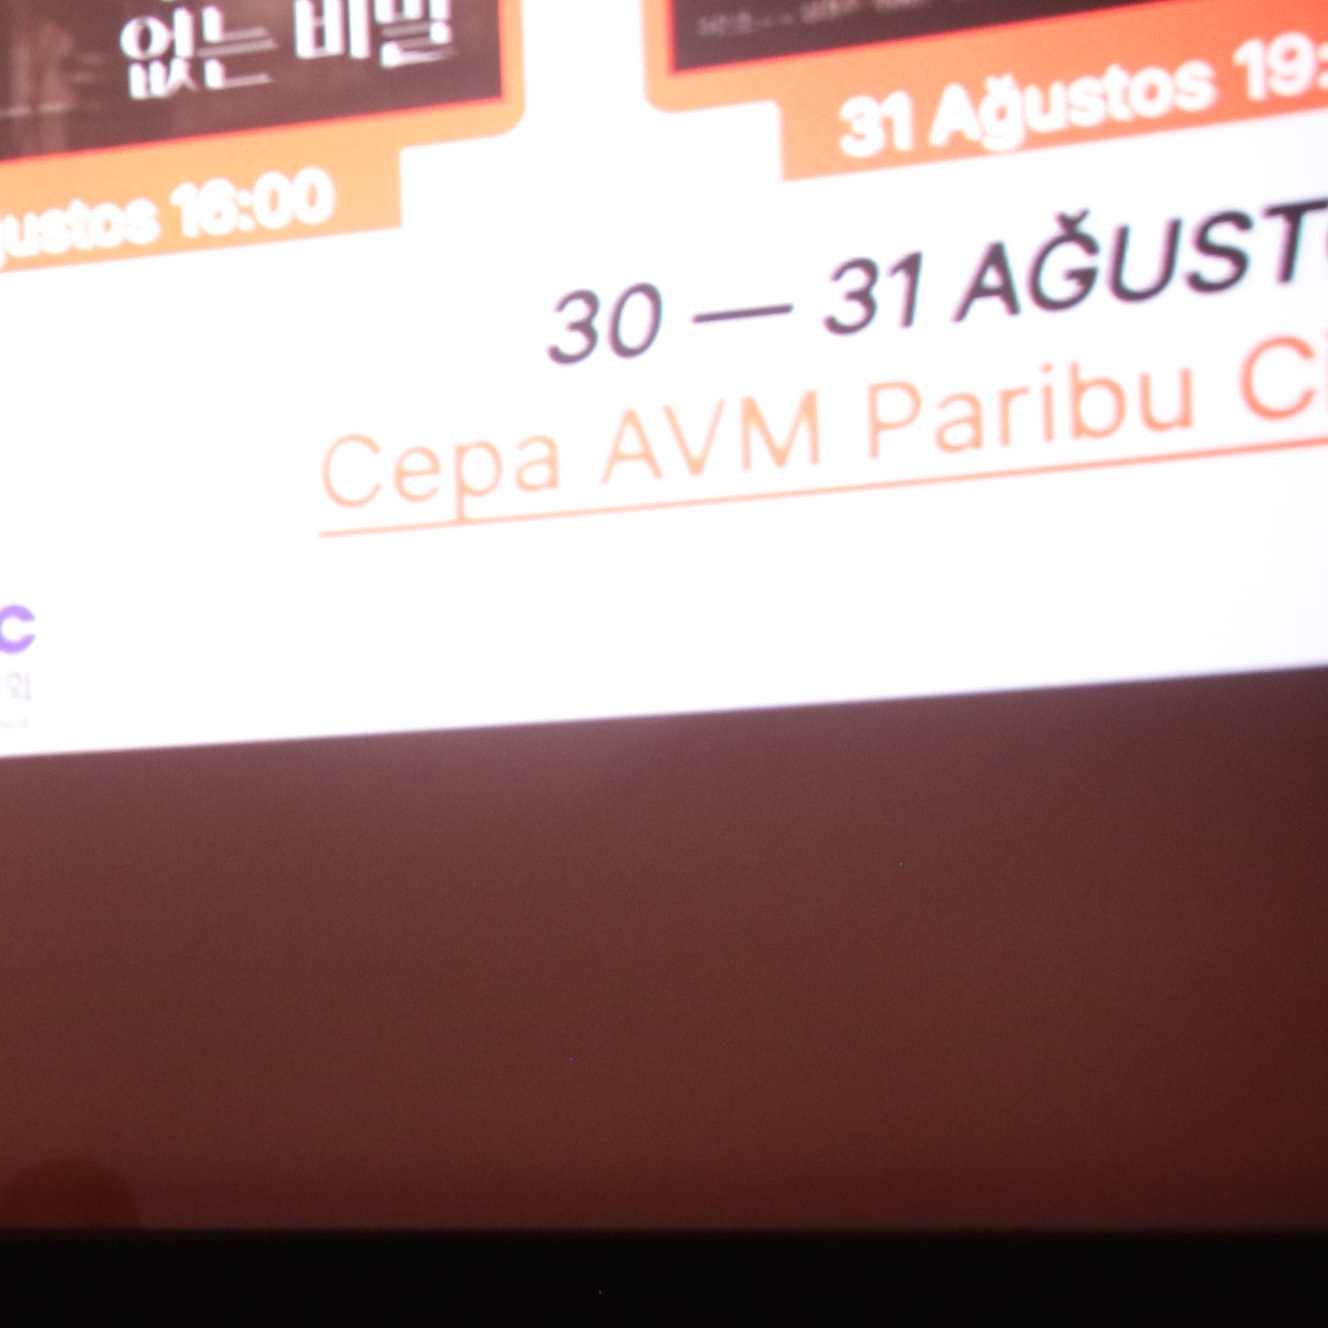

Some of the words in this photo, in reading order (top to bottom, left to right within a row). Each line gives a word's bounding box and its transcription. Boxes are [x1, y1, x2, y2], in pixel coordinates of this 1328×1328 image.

[120, 4, 279, 100] 없는
[839, 89, 915, 158] 31
[927, 58, 1219, 154] Ağustos
[169, 166, 336, 238] 16:00
[548, 281, 663, 366] 30
[823, 251, 923, 337] 31
[953, 196, 1328, 325] AĞUST
[320, 432, 560, 524] Cepa
[601, 389, 821, 485] AVM
[867, 360, 1194, 460] Paribu
[1240, 333, 1328, 421] C
